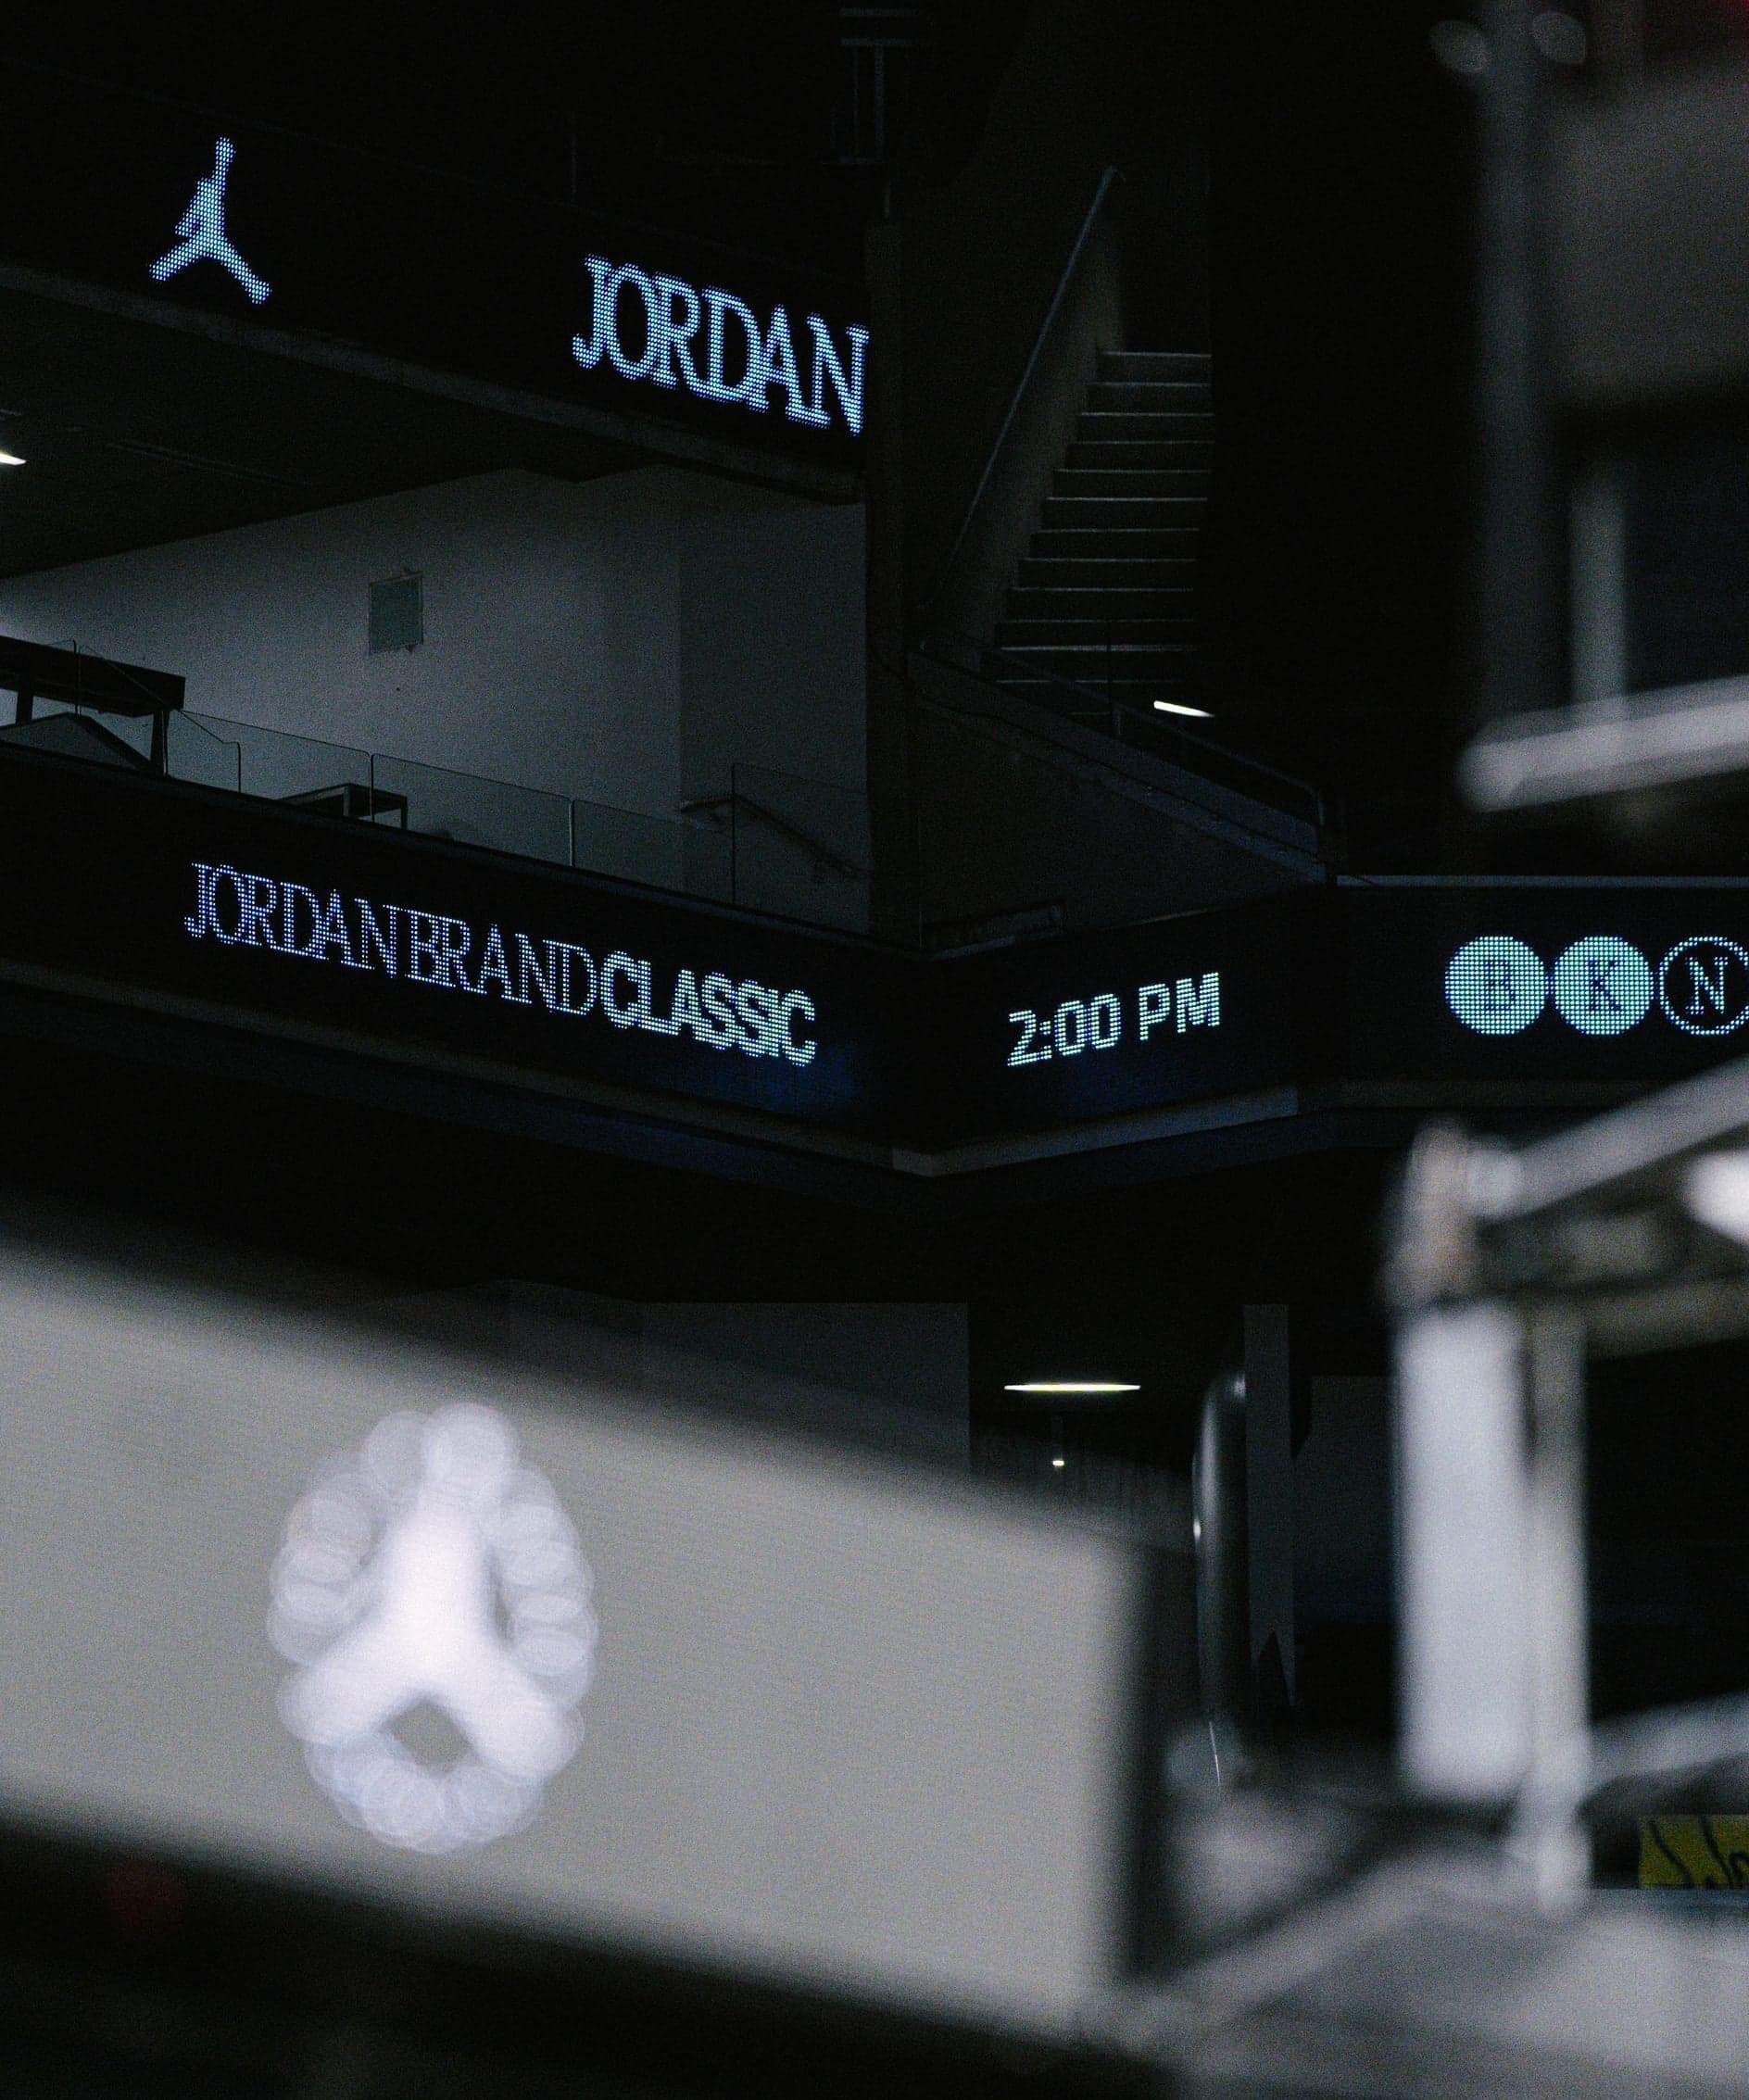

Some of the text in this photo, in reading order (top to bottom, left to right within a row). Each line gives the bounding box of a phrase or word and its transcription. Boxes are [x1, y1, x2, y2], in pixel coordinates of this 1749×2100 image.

[572, 252, 870, 437] JORDAN
[183, 861, 818, 1067] JORDAN BRAND CLASSIC
[1007, 971, 1222, 1067] 2:00 PM
